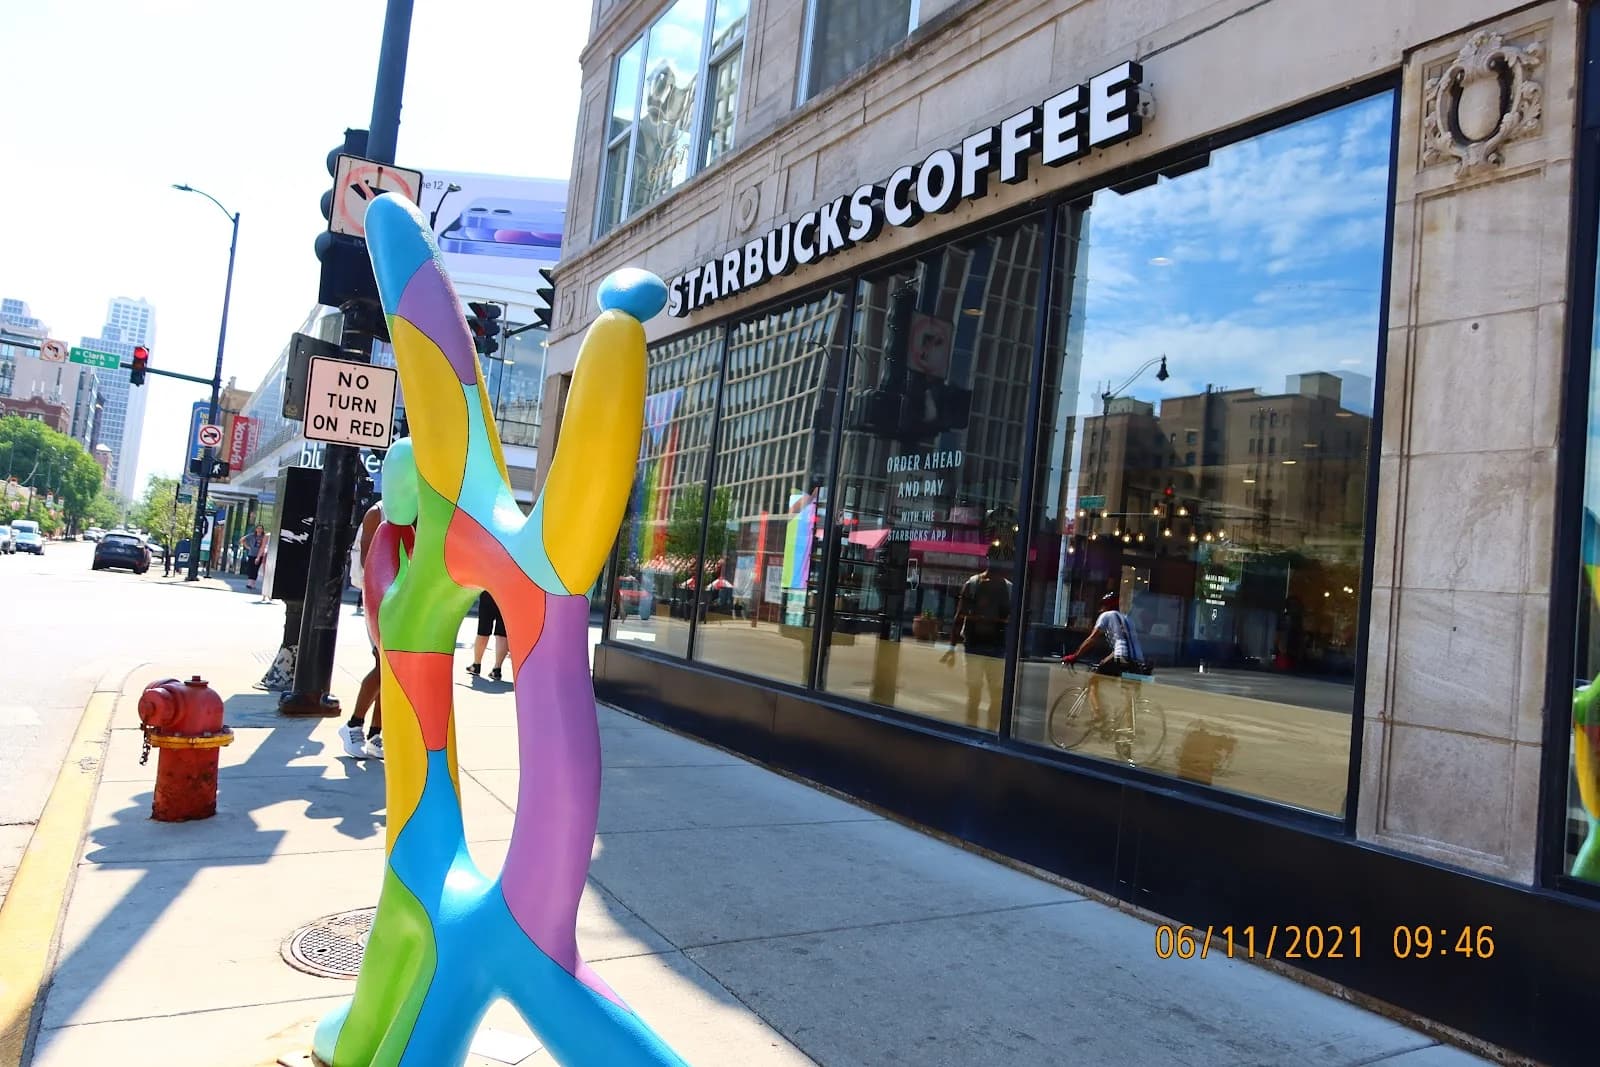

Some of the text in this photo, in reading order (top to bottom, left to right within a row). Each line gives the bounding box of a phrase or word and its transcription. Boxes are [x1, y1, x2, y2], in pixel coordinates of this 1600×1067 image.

[433, 180, 444, 190] 12
[666, 60, 1143, 319] STARBUCKS COFFEE
[82, 350, 105, 361] Clark
[338, 371, 369, 390] NO
[327, 392, 377, 414] TURN
[313, 414, 384, 438] ON RED
[887, 451, 961, 473] ORDER AHEAD
[897, 479, 944, 498] AND PAY
[901, 510, 935, 522] WITH THE
[886, 529, 947, 541] STARBUCKS APP
